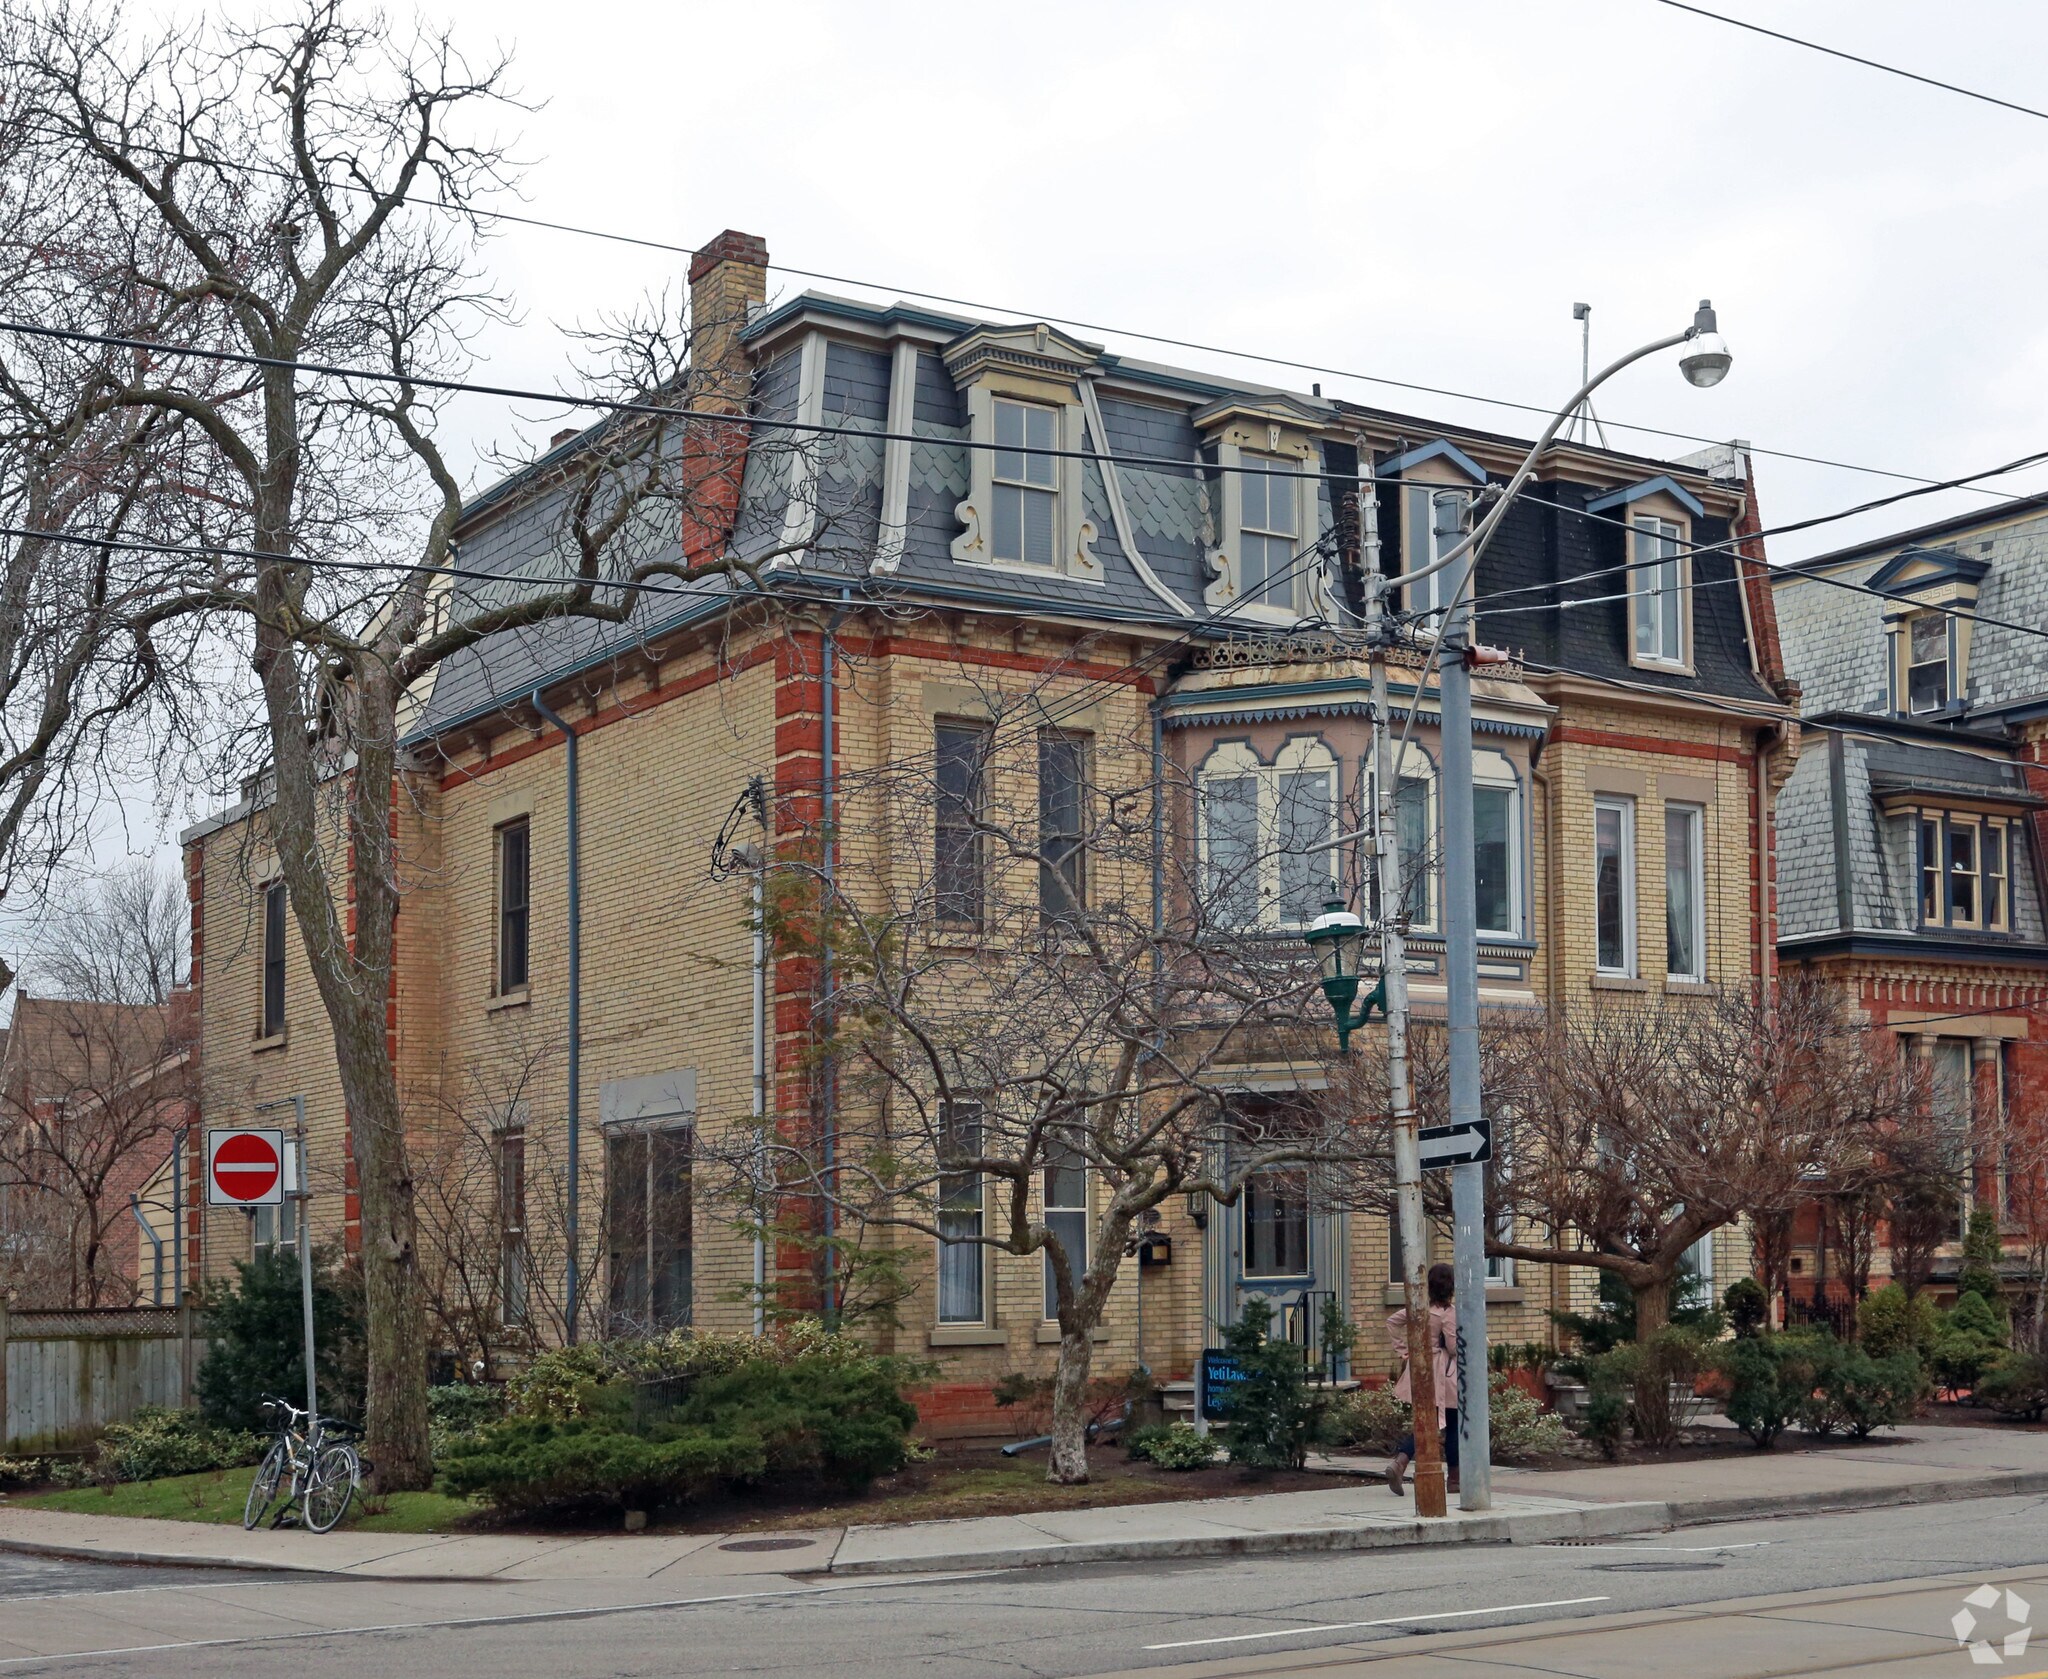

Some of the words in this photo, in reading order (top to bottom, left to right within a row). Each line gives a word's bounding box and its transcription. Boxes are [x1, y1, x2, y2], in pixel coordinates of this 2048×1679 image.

[1207, 1356, 1232, 1364] Welcome
[1208, 1366, 1225, 1380] Yeti
[1207, 1383, 1225, 1392] home
